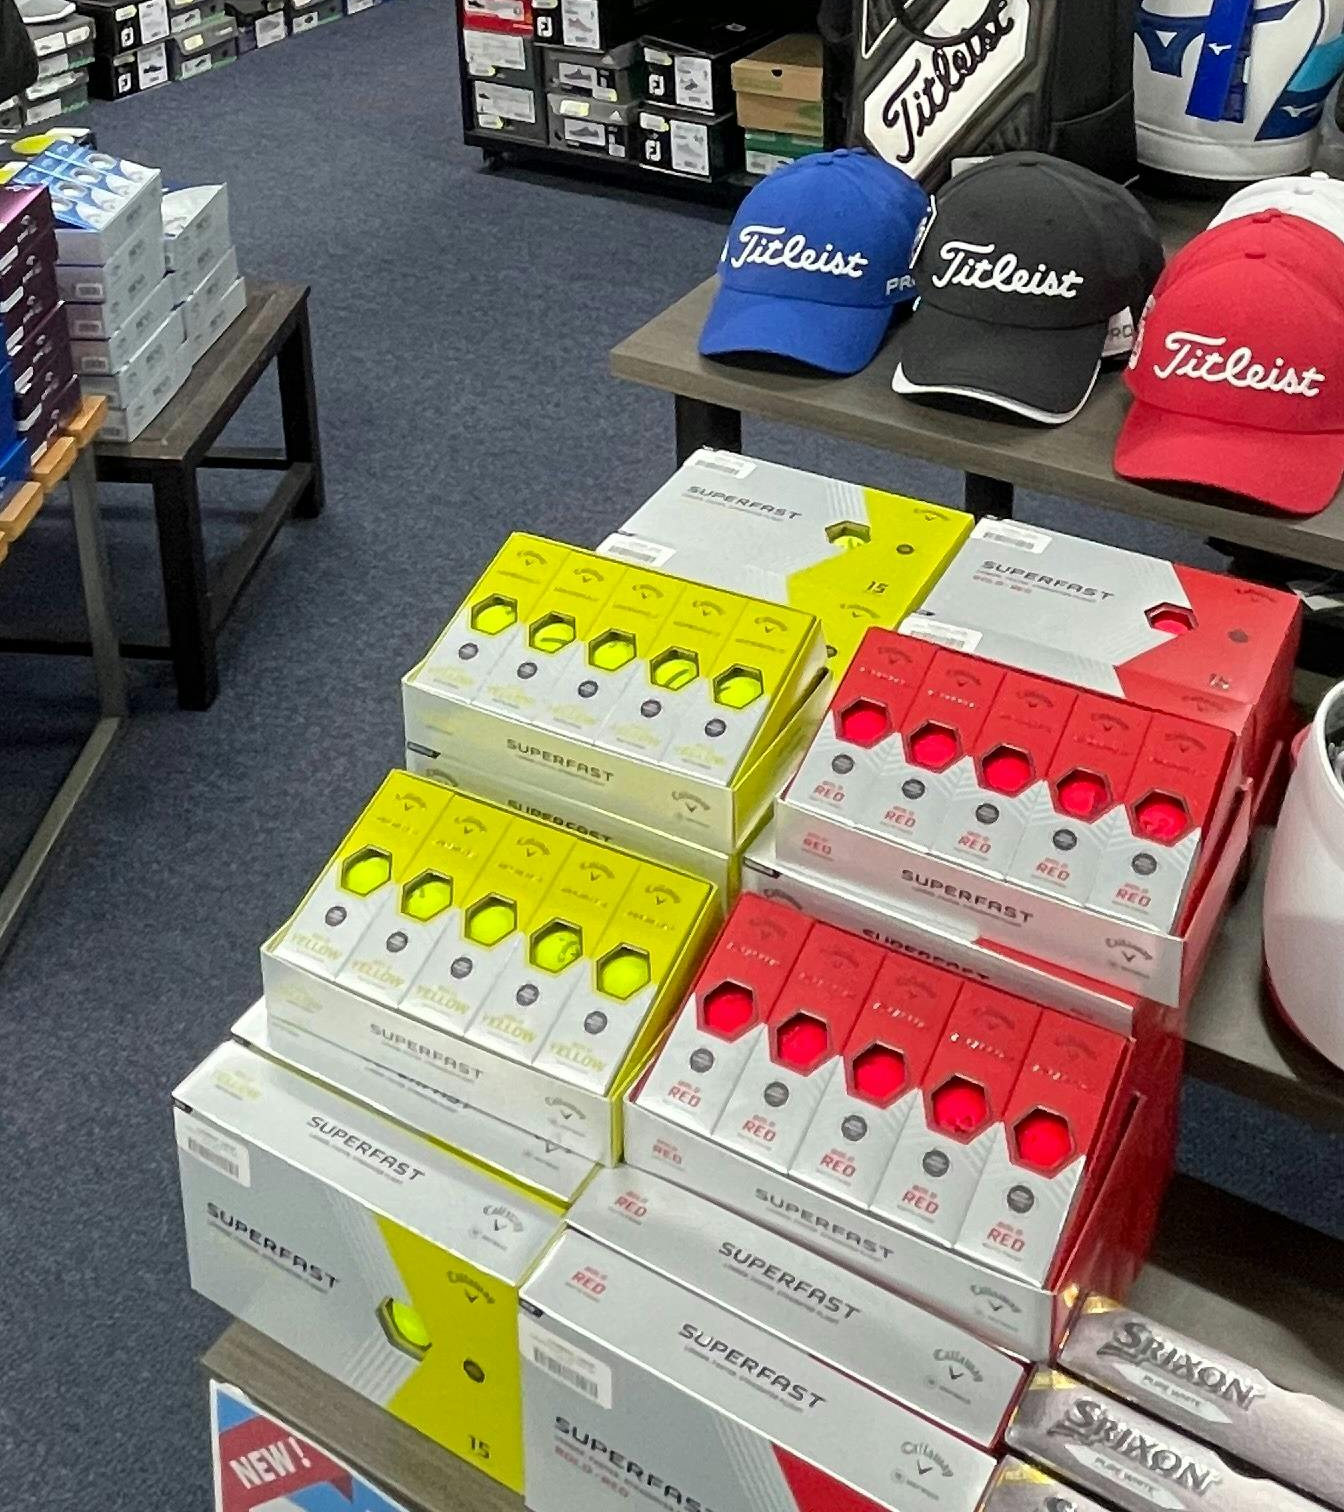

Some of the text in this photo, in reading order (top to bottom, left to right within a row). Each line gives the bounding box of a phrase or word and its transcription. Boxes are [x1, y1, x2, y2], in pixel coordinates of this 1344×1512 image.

[883, 0, 1014, 164] Titleist
[731, 226, 867, 279] Titleist
[932, 241, 1084, 298] Titleist
[1154, 331, 1326, 397] Titleist
[688, 486, 803, 520] SUPERFAST
[866, 580, 888, 594] 15
[980, 560, 1115, 603] SUPERFAST
[506, 737, 614, 783] SUPERFAST
[901, 869, 1034, 924] SUPERFAST
[370, 1023, 484, 1079] SUPERFAST
[667, 1086, 701, 1108] RED
[307, 1115, 425, 1182] SUPERFAST
[652, 1144, 683, 1165] RED
[742, 1121, 777, 1143] RED
[820, 1154, 856, 1178] RED
[615, 1196, 647, 1219] RED
[754, 1188, 895, 1259] SUPERFAST
[902, 1190, 939, 1216] RED
[207, 1201, 340, 1289] SUPERFAST
[987, 1228, 1026, 1253] RED
[572, 1271, 607, 1295] RED
[718, 1241, 863, 1320] SUPERFAST
[678, 1323, 827, 1410] SUPERFAST
[1097, 1320, 1267, 1413] SRIXON
[230, 1436, 313, 1490] NEW!
[468, 1434, 490, 1459] 15
[901, 1441, 955, 1478] Callaway
[1047, 1397, 1223, 1498] SRIXON
